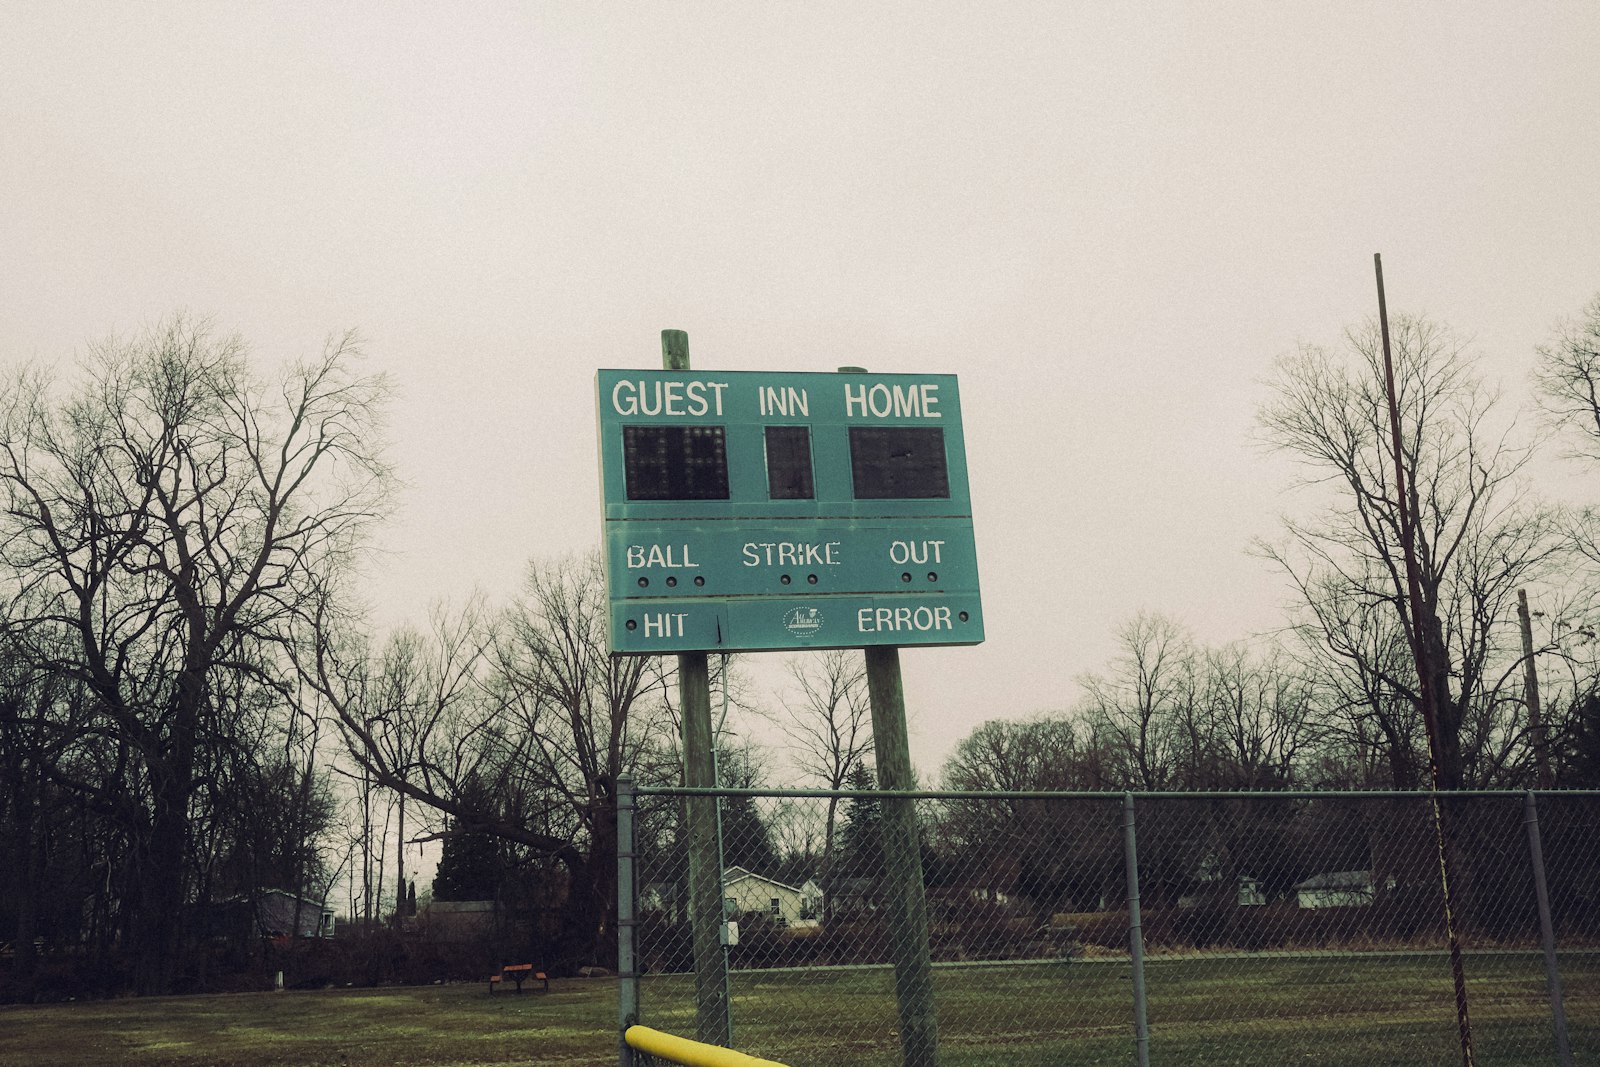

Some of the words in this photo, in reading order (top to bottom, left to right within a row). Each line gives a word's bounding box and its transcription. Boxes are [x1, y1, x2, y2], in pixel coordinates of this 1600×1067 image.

[612, 379, 729, 417] GUEST
[758, 385, 809, 418] INN
[845, 383, 942, 419] HOME
[627, 544, 699, 569] BALL
[742, 541, 841, 567] STRIKE
[889, 540, 945, 565] OUT
[644, 613, 689, 637] HIT
[857, 607, 953, 632] ERROR
